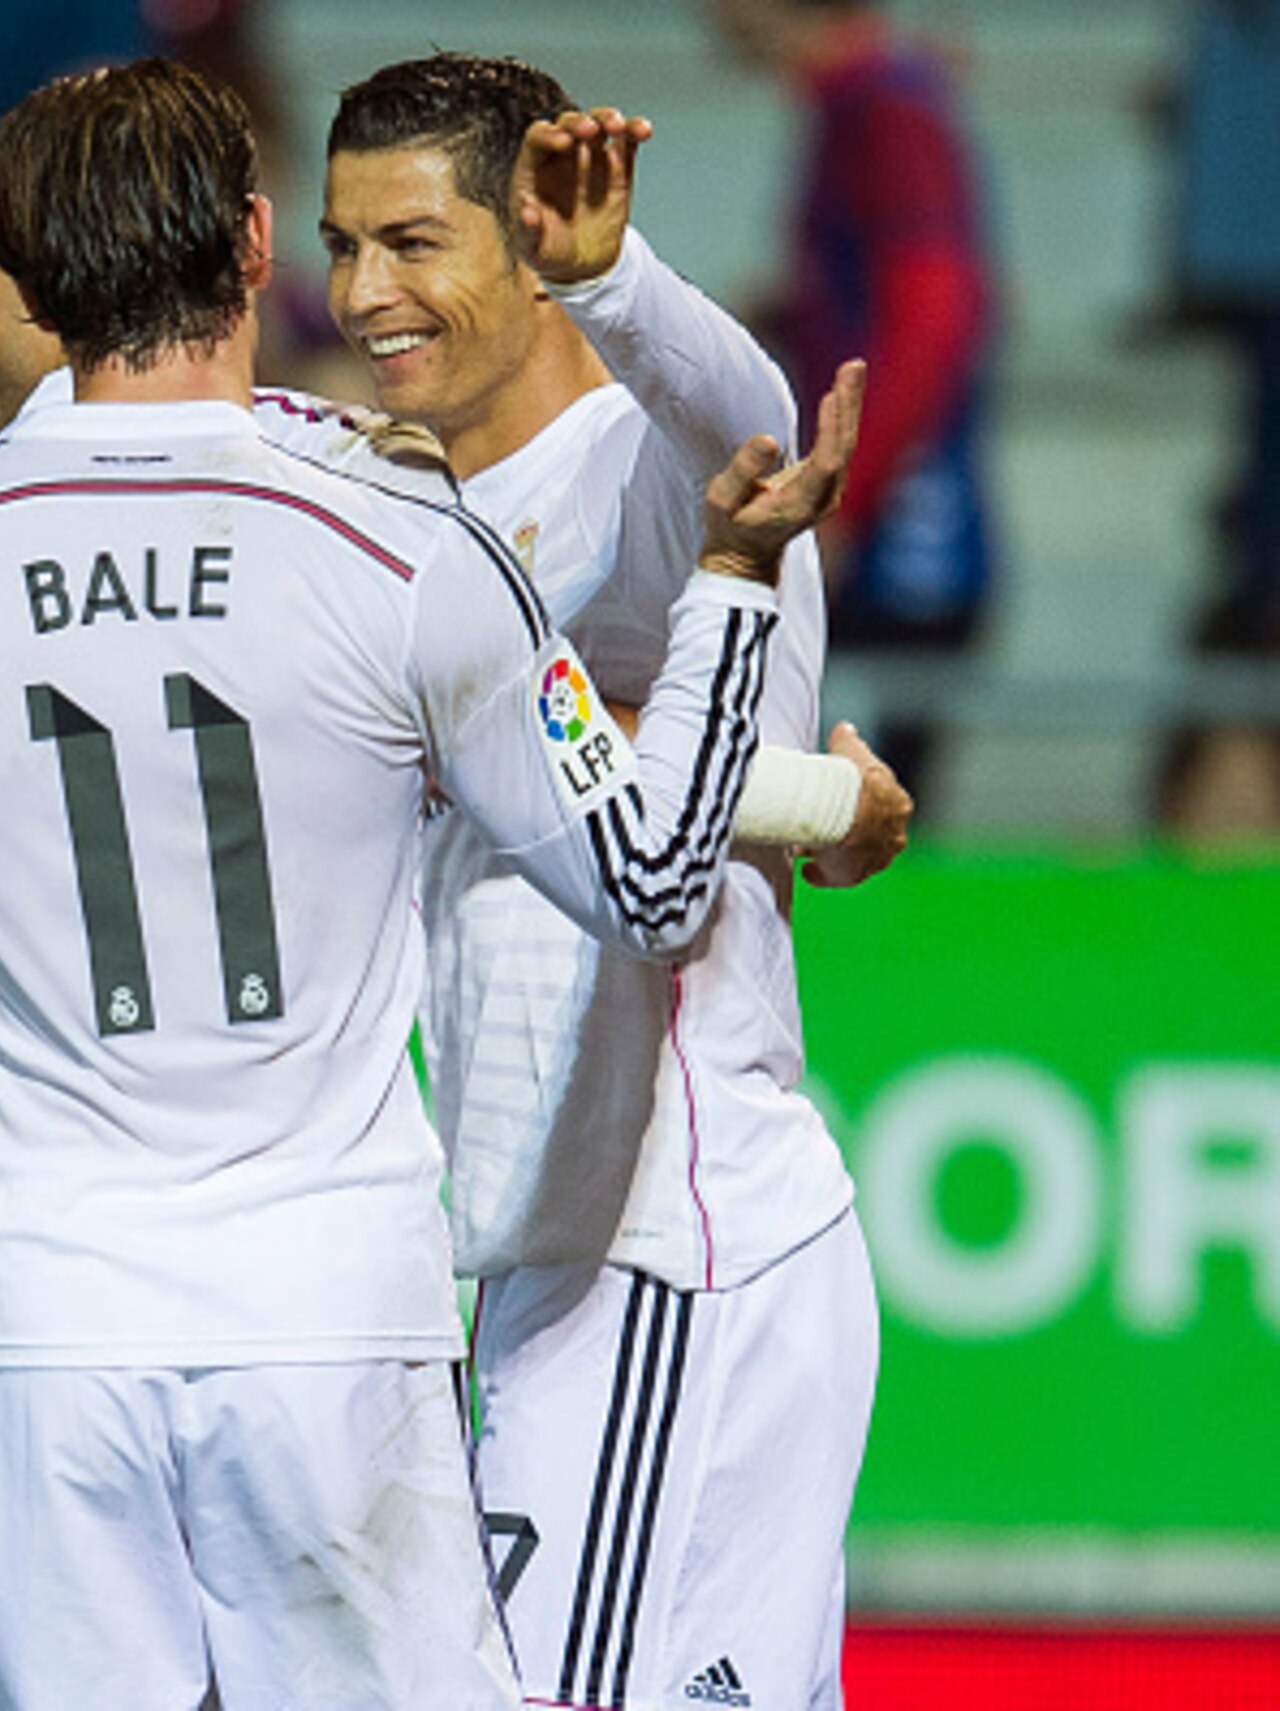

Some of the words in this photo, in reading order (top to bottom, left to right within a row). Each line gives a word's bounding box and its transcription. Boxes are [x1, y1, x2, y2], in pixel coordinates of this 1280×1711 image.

[22, 546, 232, 634] BALE
[559, 732, 615, 797] LFP
[24, 672, 285, 1038] 11
